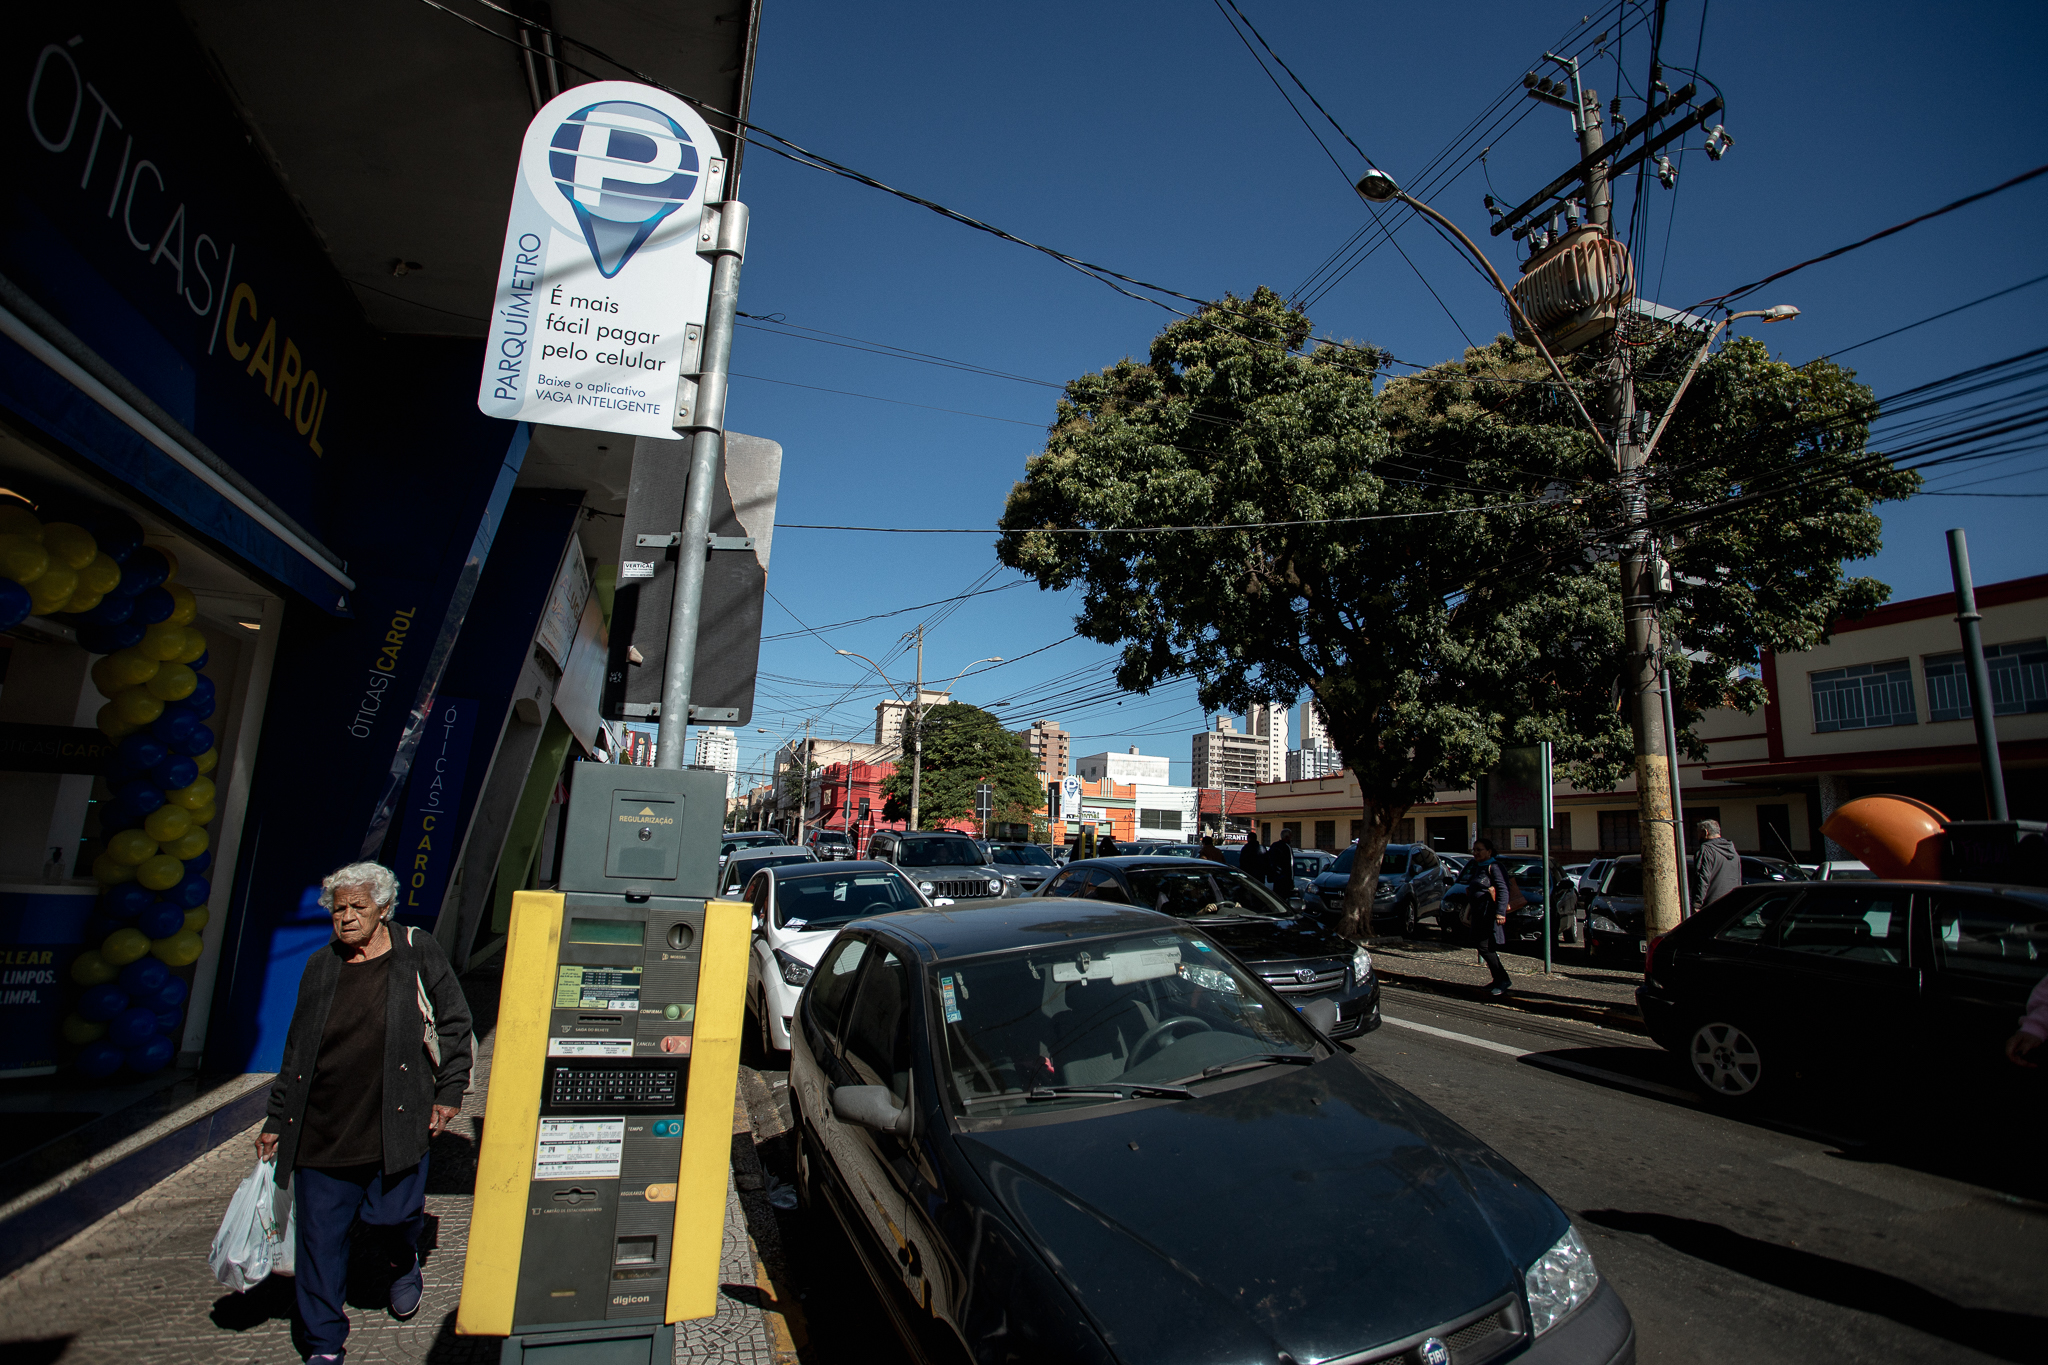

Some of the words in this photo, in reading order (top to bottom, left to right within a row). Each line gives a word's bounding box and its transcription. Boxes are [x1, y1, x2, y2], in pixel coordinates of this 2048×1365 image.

[27, 33, 219, 316] ÓTICAS
[226, 282, 328, 459] CAROL
[550, 285, 563, 306] É
[570, 297, 619, 314] mais
[494, 232, 542, 401] PARQUÍMETRO
[546, 313, 589, 336] fácil
[597, 326, 660, 348] pagar
[542, 342, 588, 361] pelo
[596, 350, 666, 373] celular
[535, 388, 573, 404] VAGA
[577, 393, 661, 415] INTELIGENTE
[538, 374, 572, 390] Baixe
[576, 381, 584, 391] o
[587, 381, 647, 399] aplicativo
[347, 676, 389, 739] ÓTICAS
[376, 606, 417, 672] CAROL
[427, 704, 458, 807] ÓTICAS
[619, 815, 673, 826] REGULARIZAÇÃO
[408, 815, 436, 907] CAROL
[2, 969, 57, 985] LIMPOS.
[612, 1294, 650, 1306] digicon
[1428, 1348, 1447, 1365] FIAT
